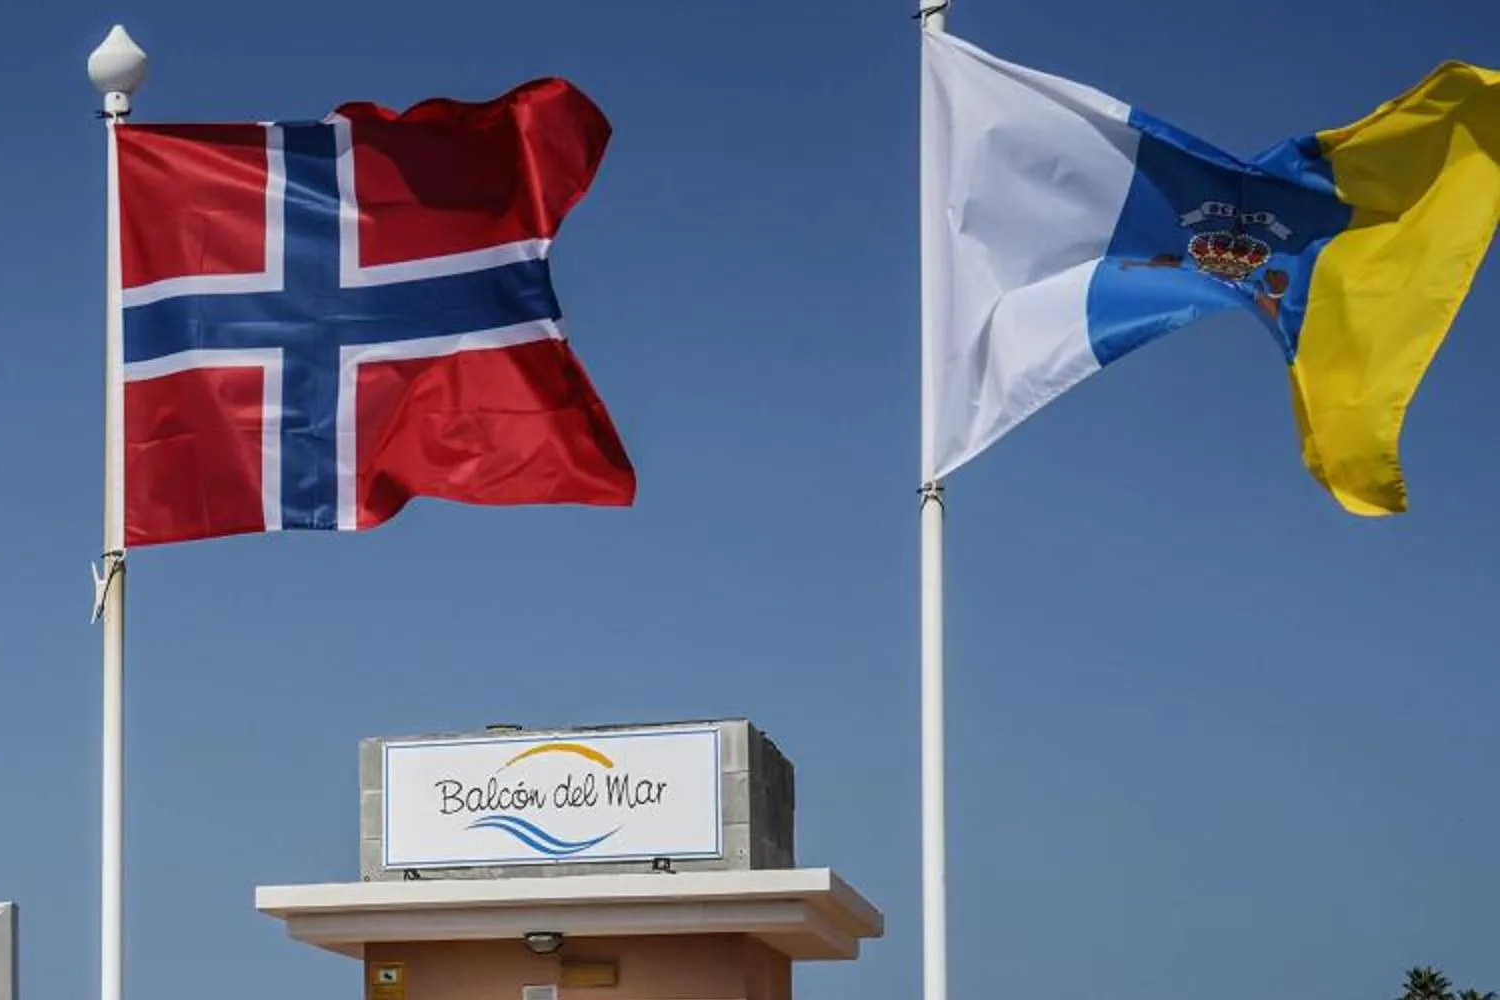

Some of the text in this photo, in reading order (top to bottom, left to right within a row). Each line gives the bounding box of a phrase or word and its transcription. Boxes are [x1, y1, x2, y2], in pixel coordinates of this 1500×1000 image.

[435, 773, 668, 815] Balcón del Mar
